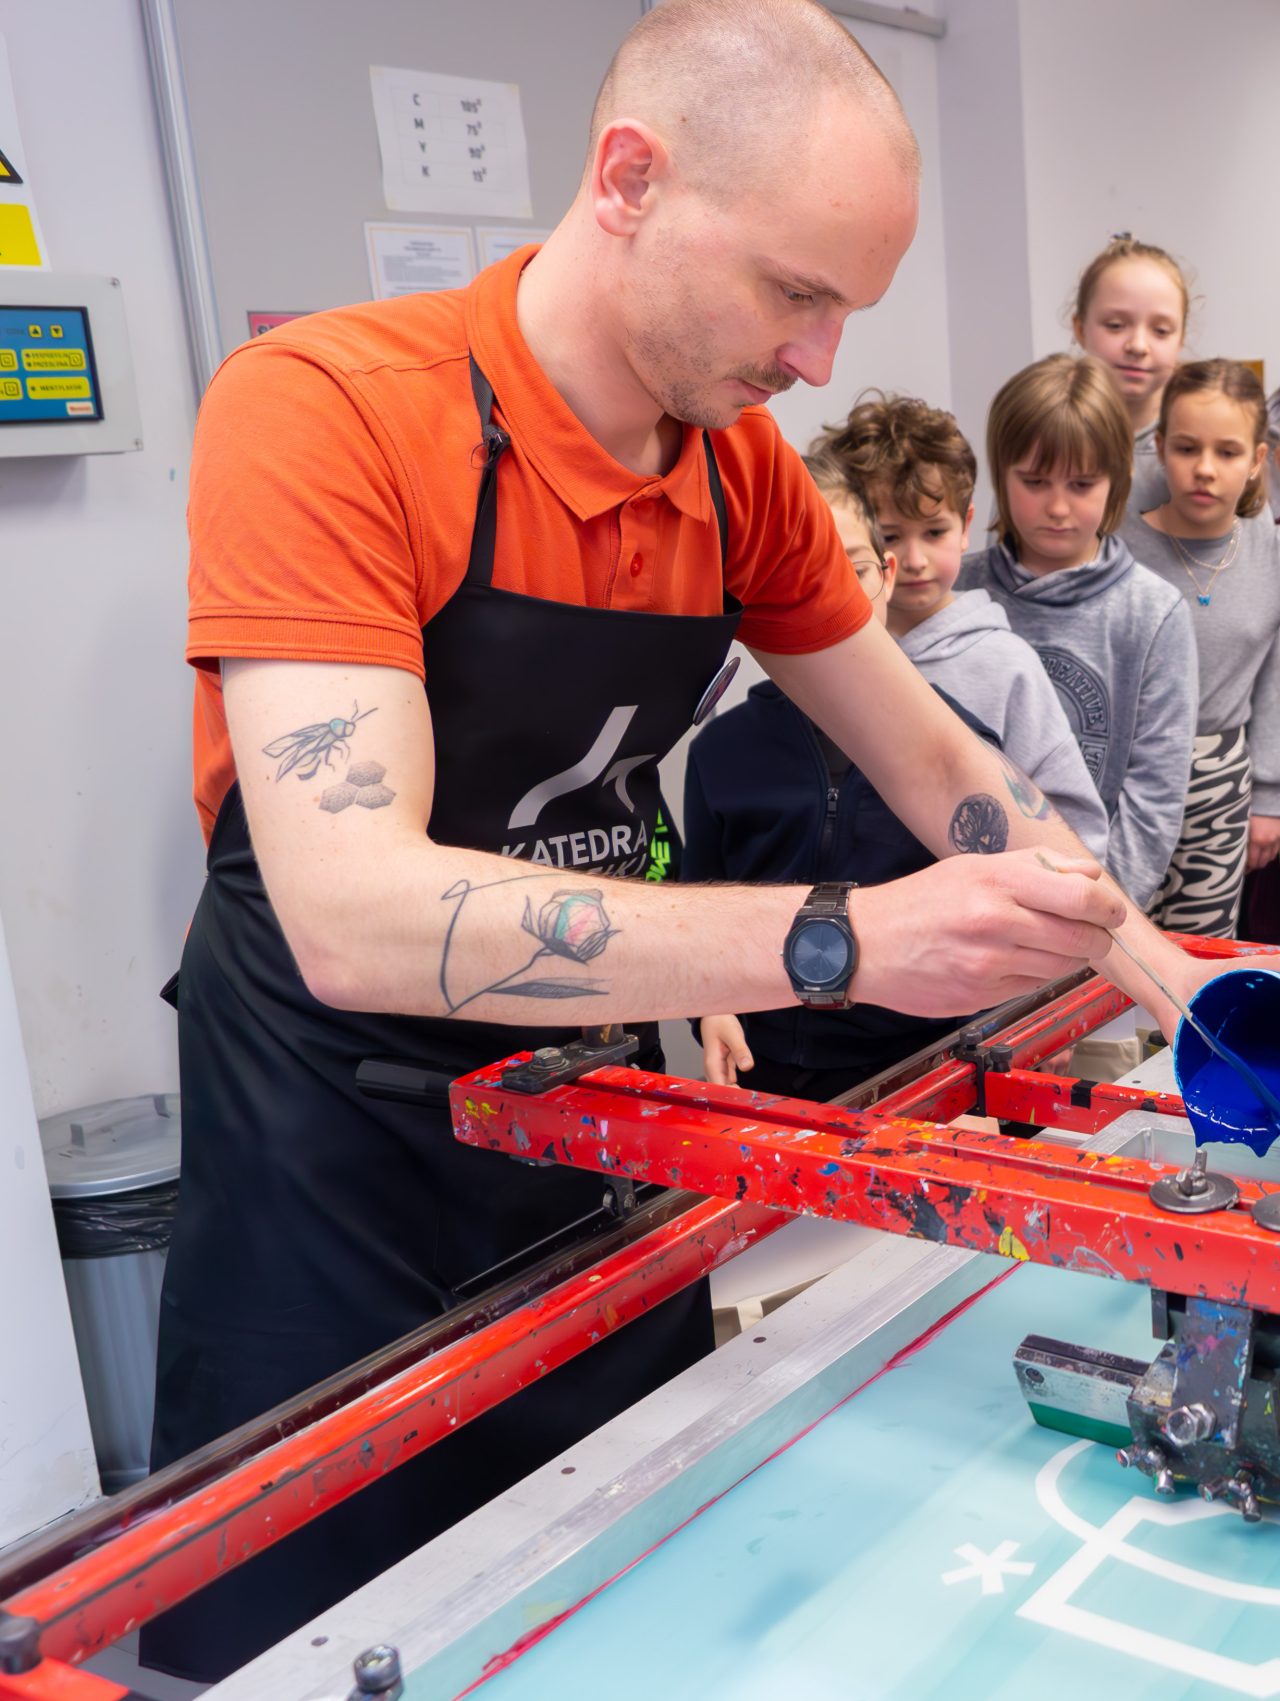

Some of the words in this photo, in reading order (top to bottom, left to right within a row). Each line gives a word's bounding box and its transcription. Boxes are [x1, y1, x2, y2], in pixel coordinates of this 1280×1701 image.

[412, 93, 421, 107] C
[414, 118, 425, 130] M
[1042, 655, 1105, 725] REATIVE
